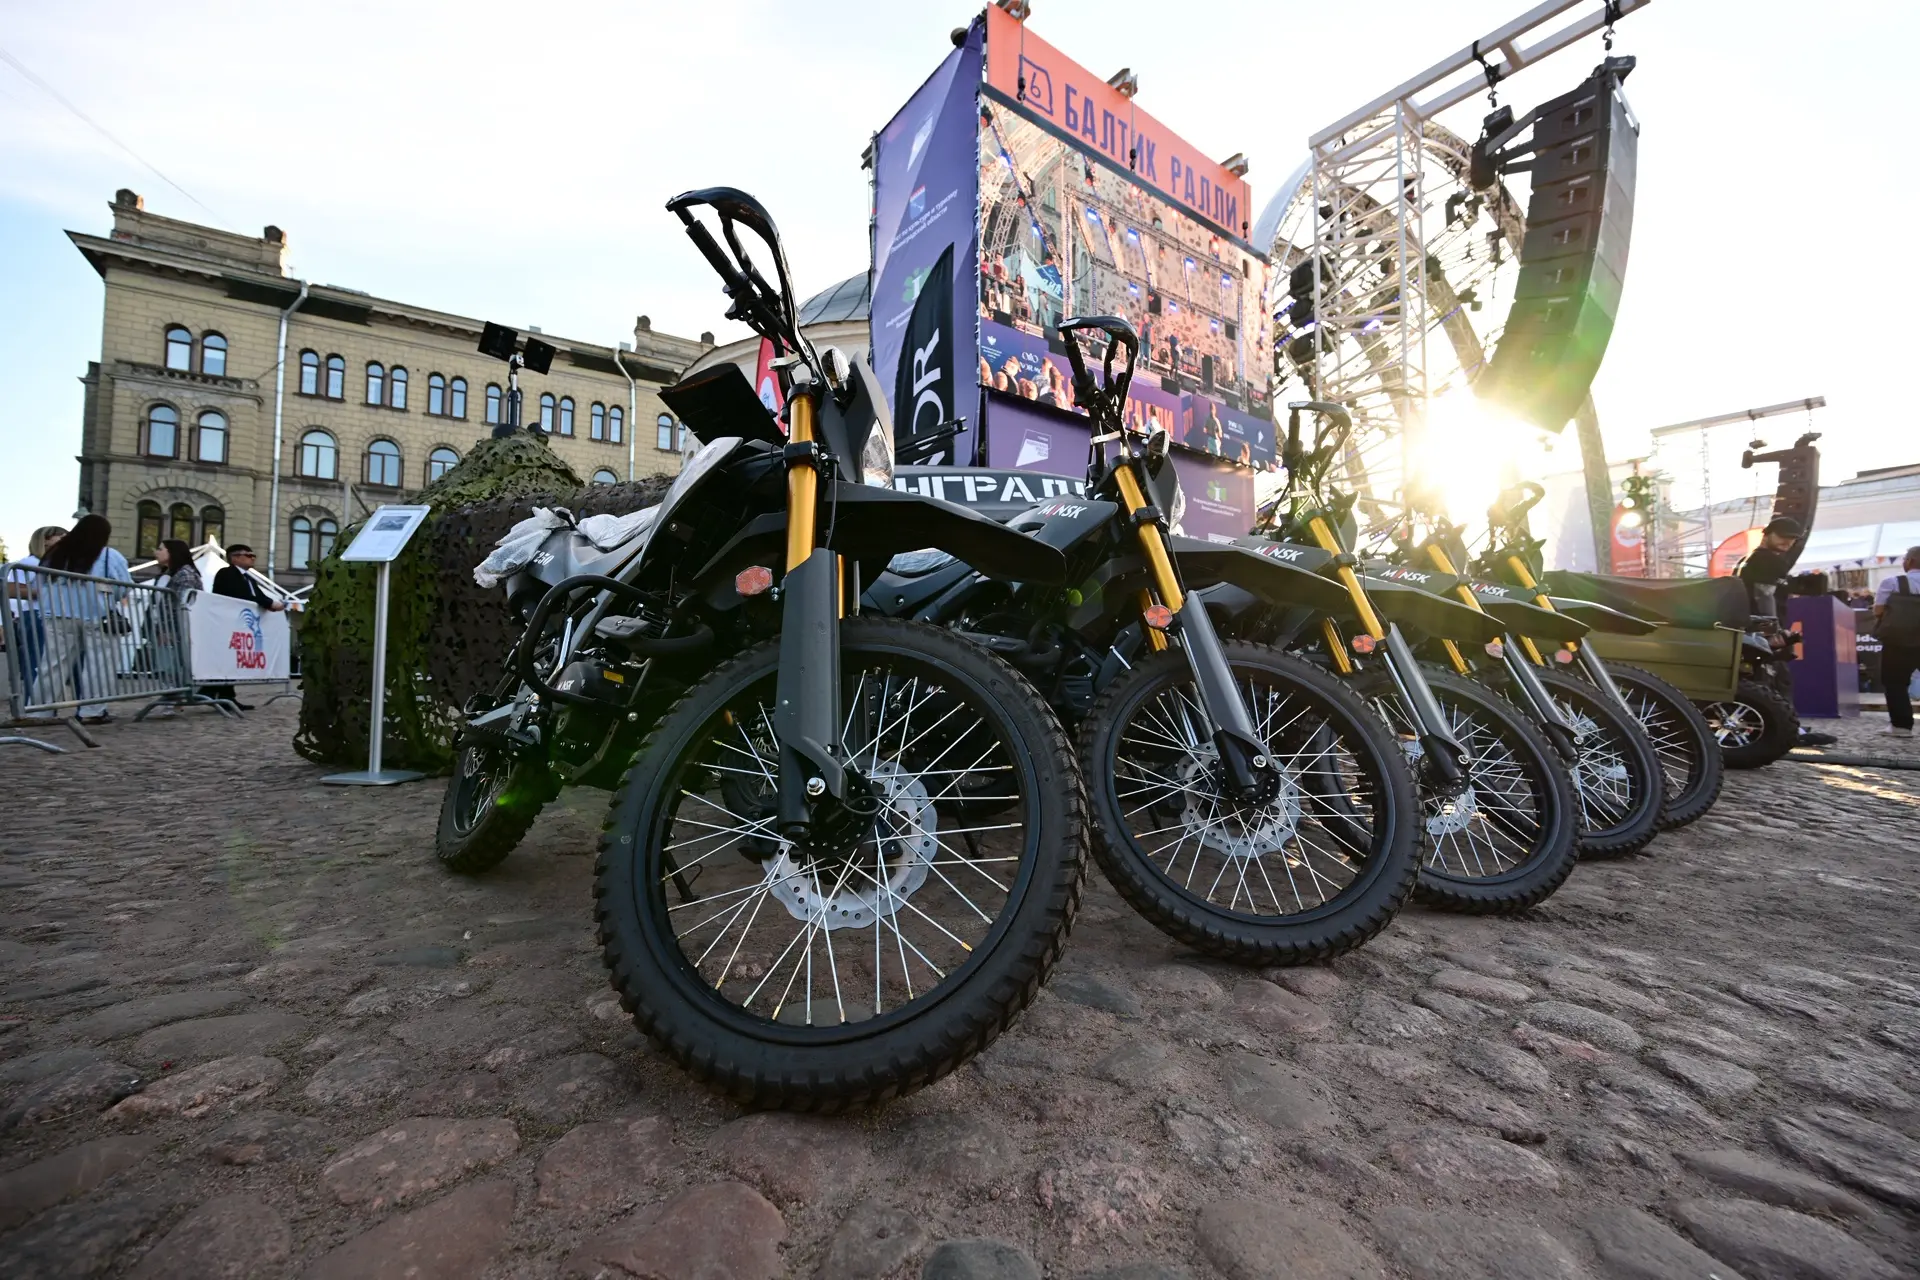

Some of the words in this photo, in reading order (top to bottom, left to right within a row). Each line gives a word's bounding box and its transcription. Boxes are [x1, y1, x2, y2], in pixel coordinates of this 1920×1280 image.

[1065, 83, 1157, 182] БАЛТИК
[1171, 155, 1238, 231] РАЛЛИ
[1037, 501, 1088, 519] MINSK
[1253, 543, 1304, 562] MINSK
[1380, 568, 1431, 584] MINSK
[1469, 582, 1510, 597] MINSK
[229, 631, 254, 651] АВТО
[236, 650, 266, 669] РАДИО
